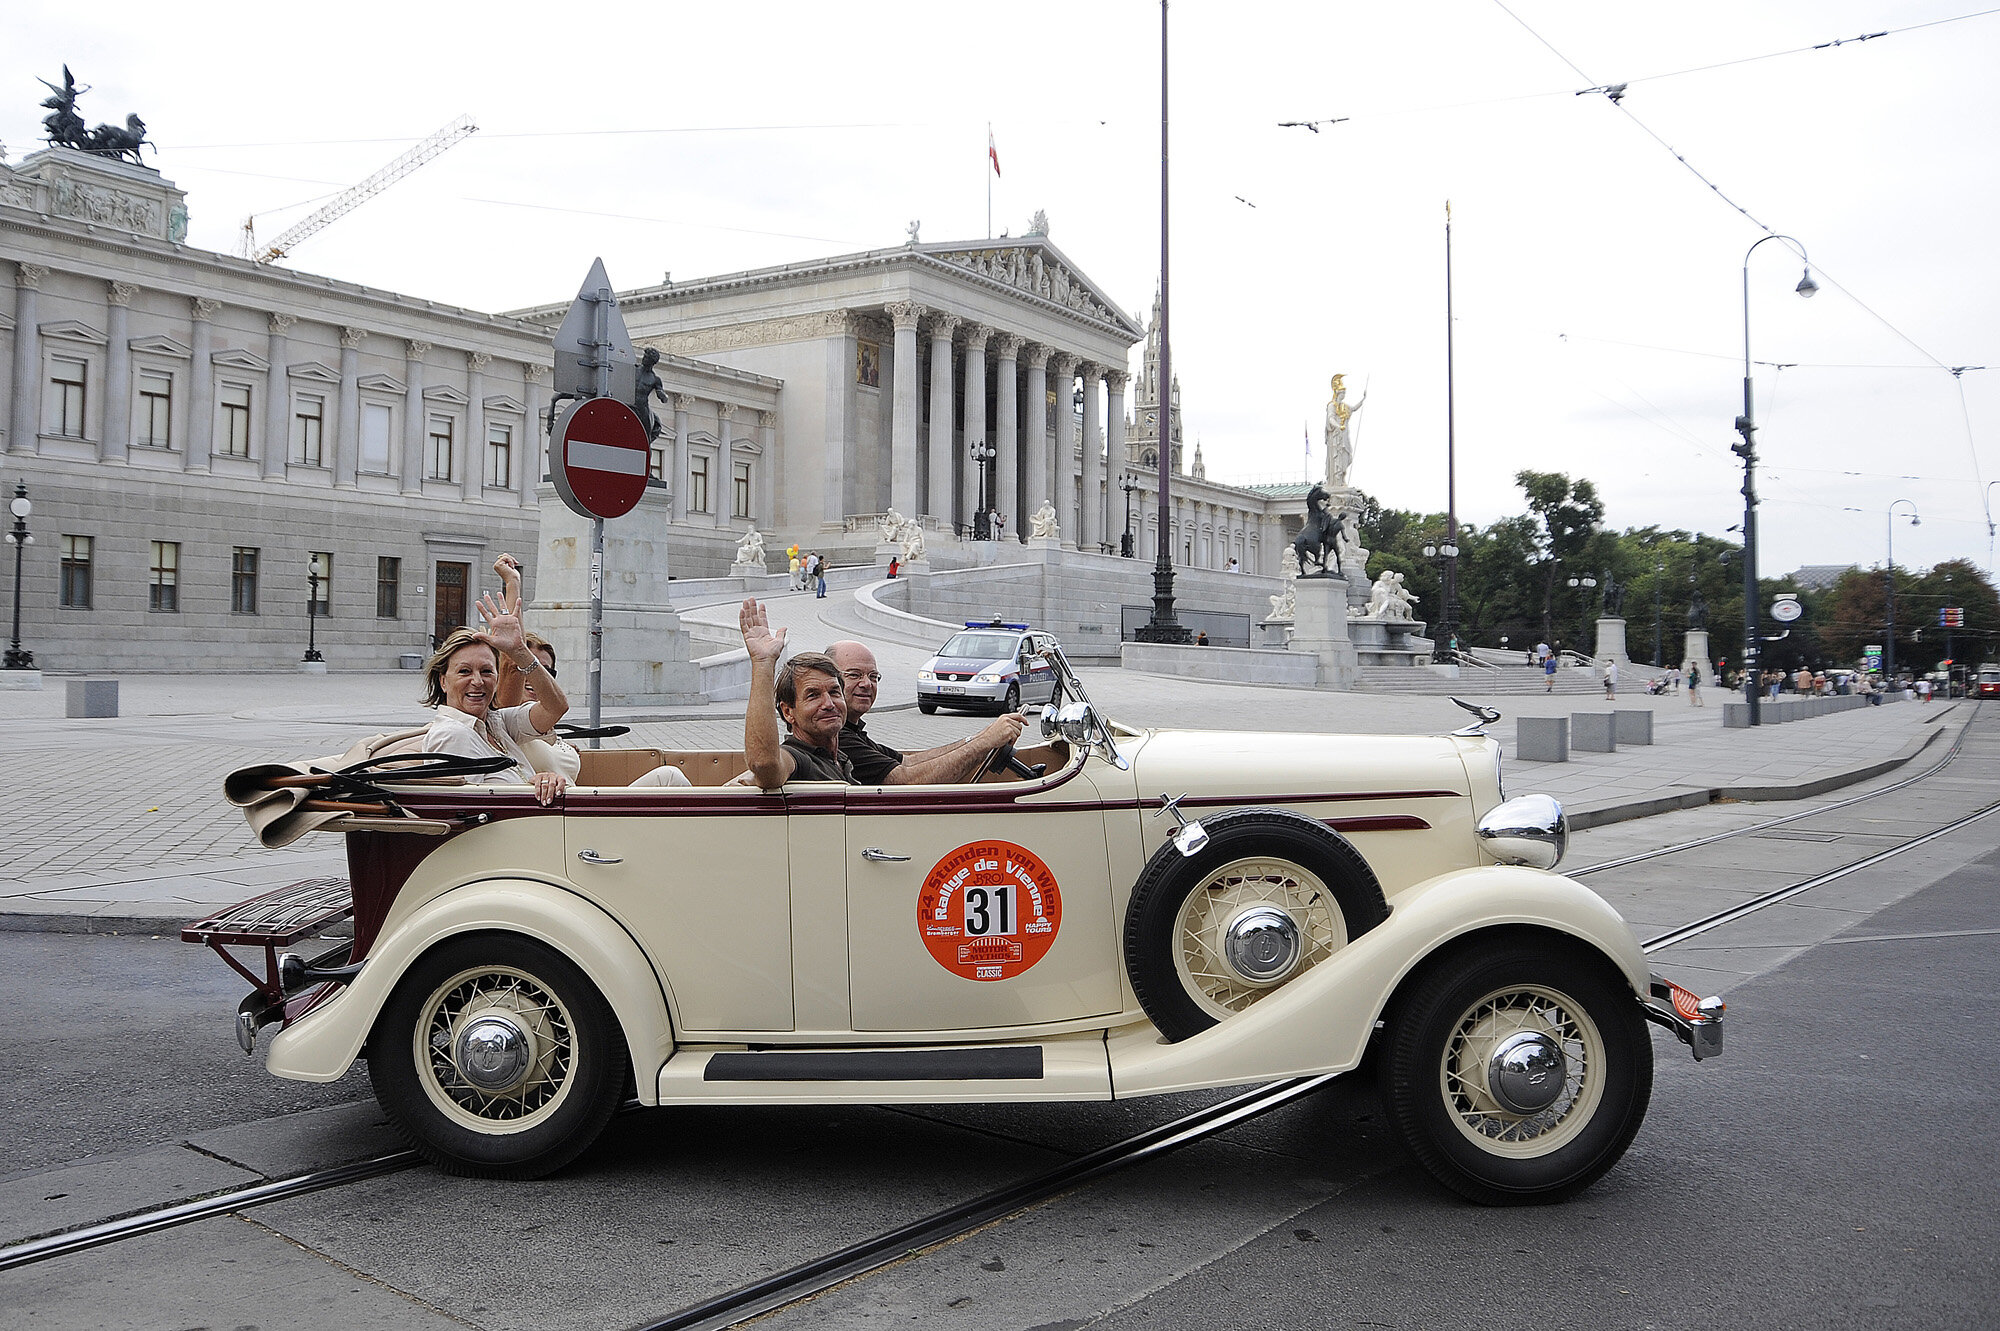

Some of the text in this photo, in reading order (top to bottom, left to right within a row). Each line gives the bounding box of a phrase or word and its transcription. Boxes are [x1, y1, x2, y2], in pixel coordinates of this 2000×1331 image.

[1029, 672, 1047, 683] POLIZEI
[921, 846, 1056, 920] 24 Stunden von Wien
[935, 858, 1043, 920] Rallye de Vienne
[966, 887, 1008, 935] 31
[972, 944, 1008, 953] MOTOR
[976, 969, 1002, 978] CLASSIC
